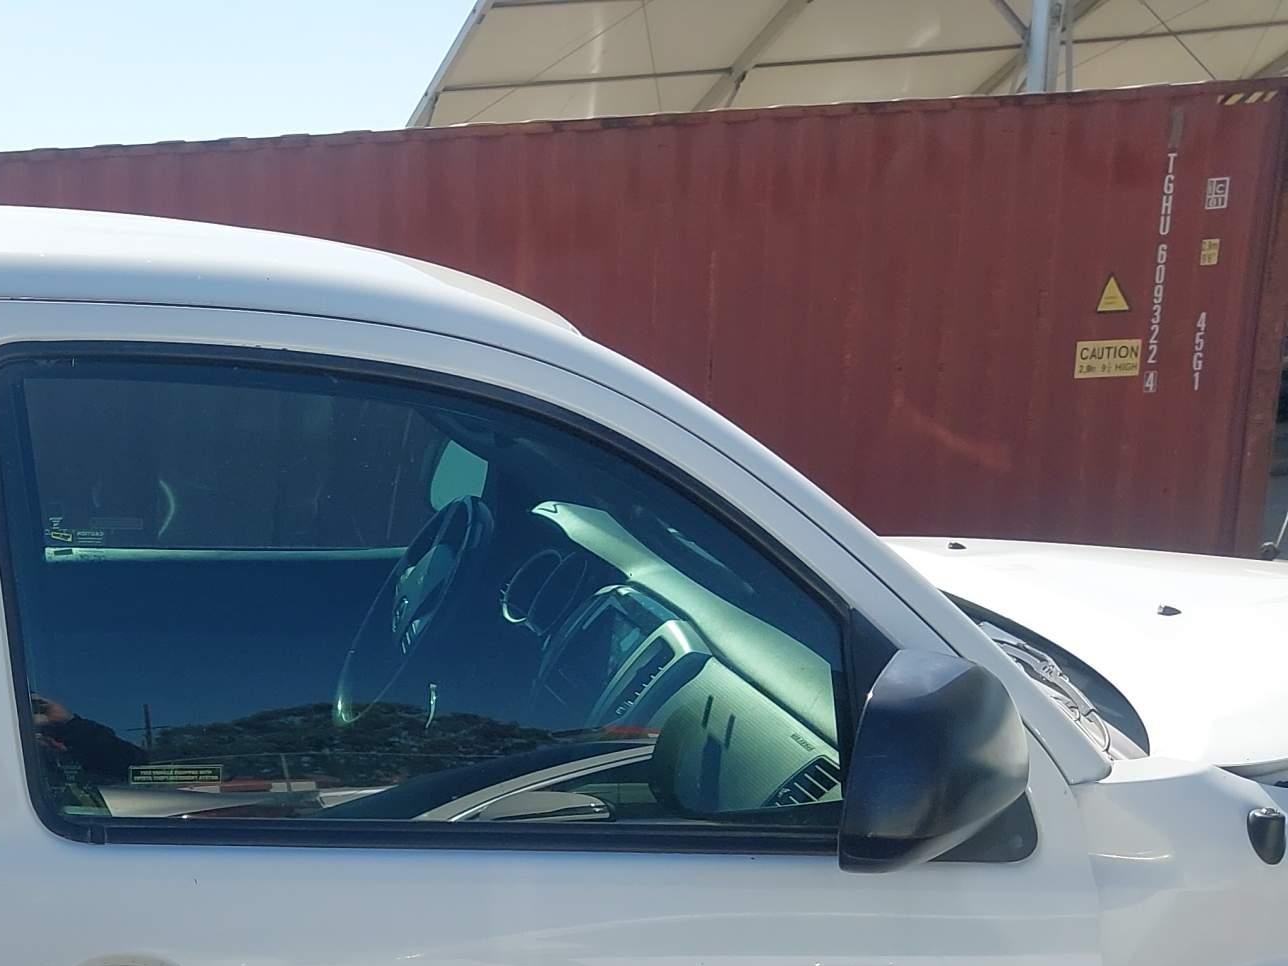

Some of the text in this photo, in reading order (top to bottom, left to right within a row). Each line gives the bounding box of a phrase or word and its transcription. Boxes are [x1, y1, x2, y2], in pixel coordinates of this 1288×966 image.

[1145, 153, 1178, 392] TGHU 609322 4
[1080, 345, 1139, 360] CAUTION
[1192, 311, 1207, 391] 45G1
